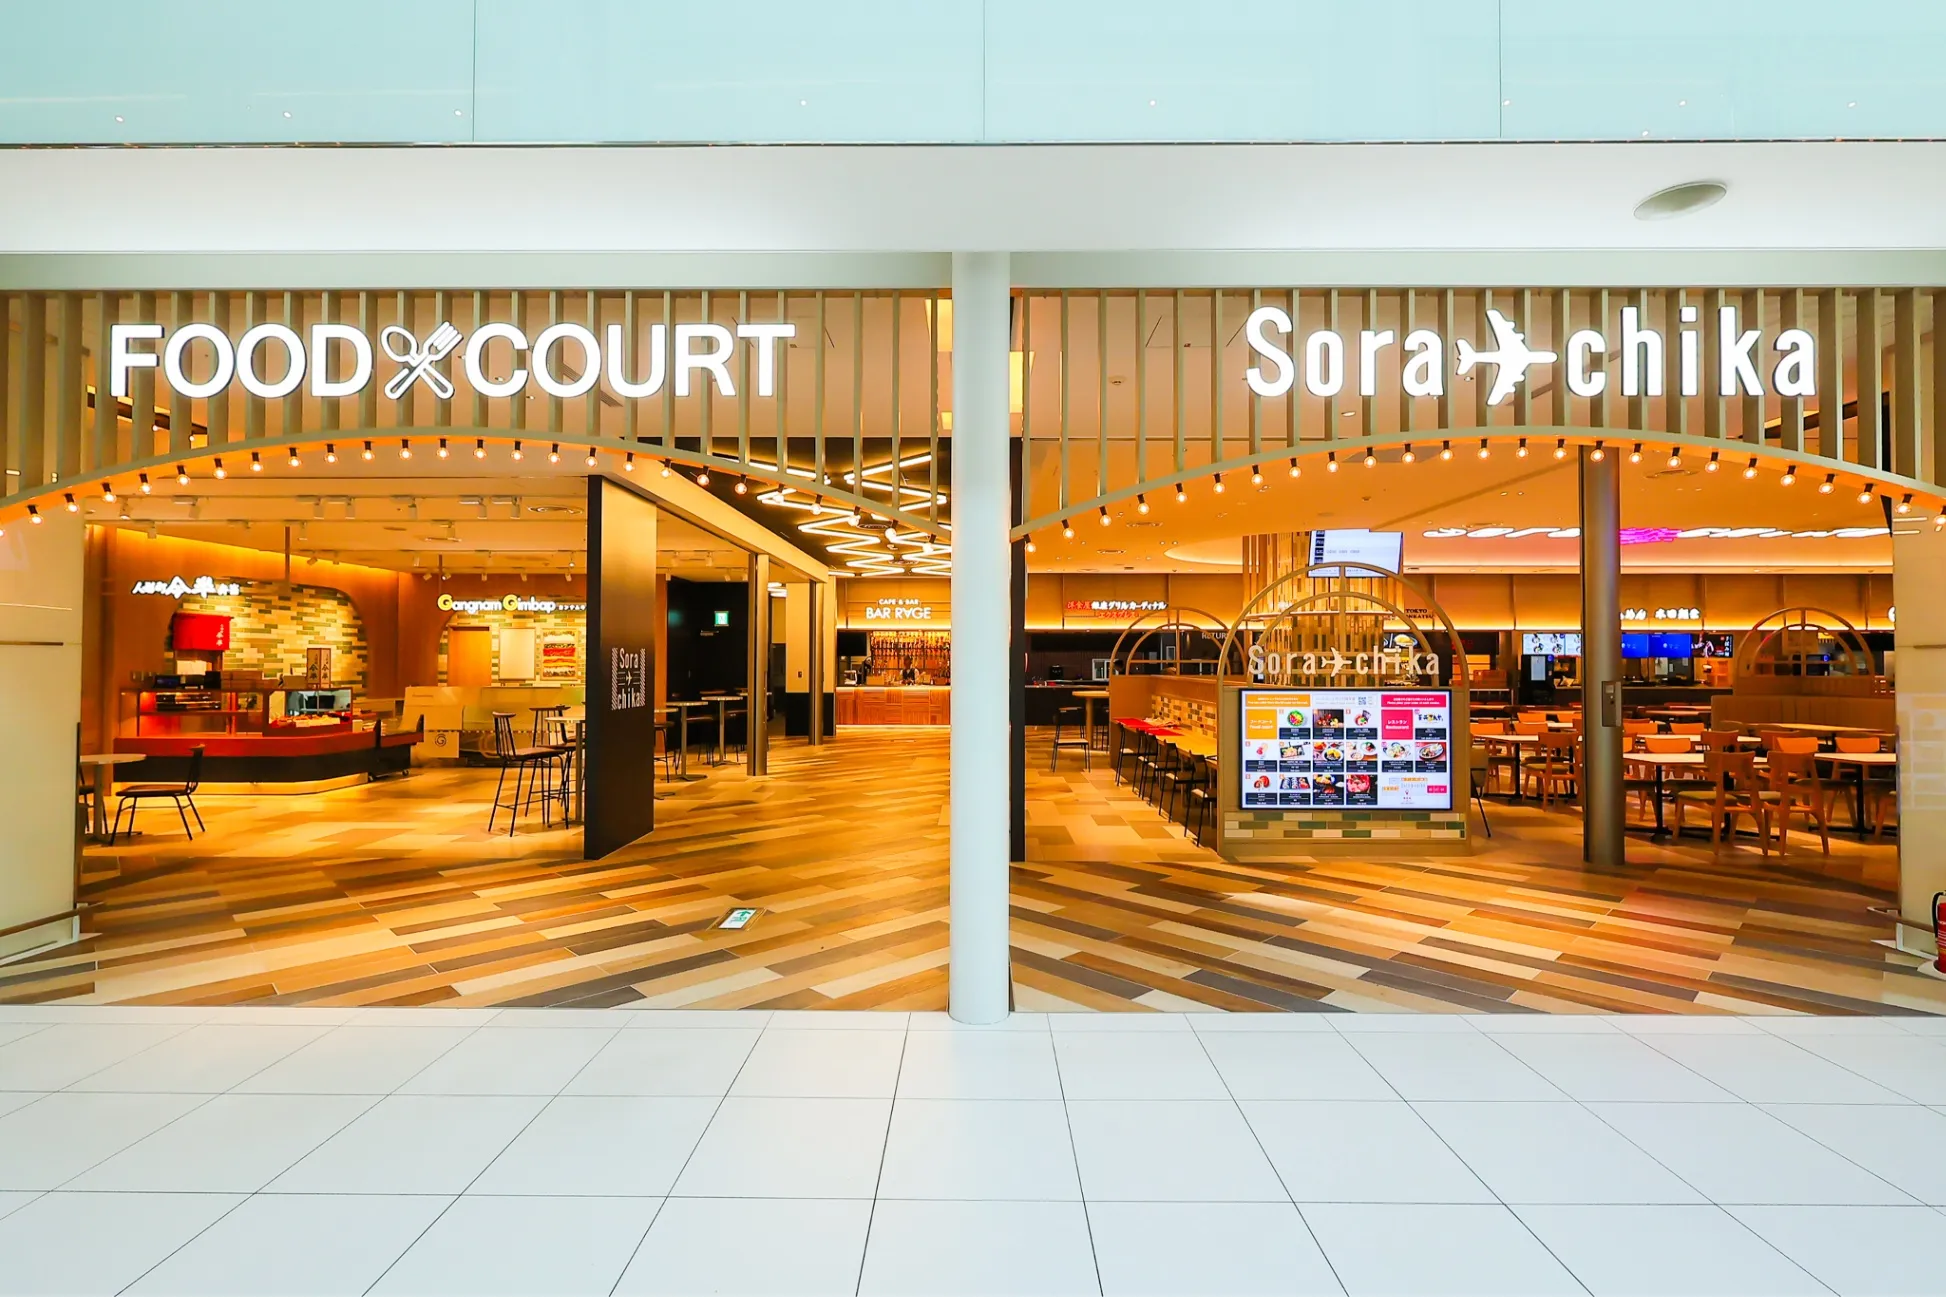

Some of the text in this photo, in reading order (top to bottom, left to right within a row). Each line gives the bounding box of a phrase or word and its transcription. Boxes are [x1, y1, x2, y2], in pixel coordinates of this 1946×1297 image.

[110, 323, 796, 398] FOOD COURT
[1245, 306, 1817, 397] Sora chika
[437, 594, 502, 614] Gangnam
[502, 594, 556, 613] Gimbap
[866, 607, 891, 619] BAR
[619, 647, 639, 669] Sora
[1248, 645, 1440, 675] Sora chika
[617, 687, 641, 710] chika
